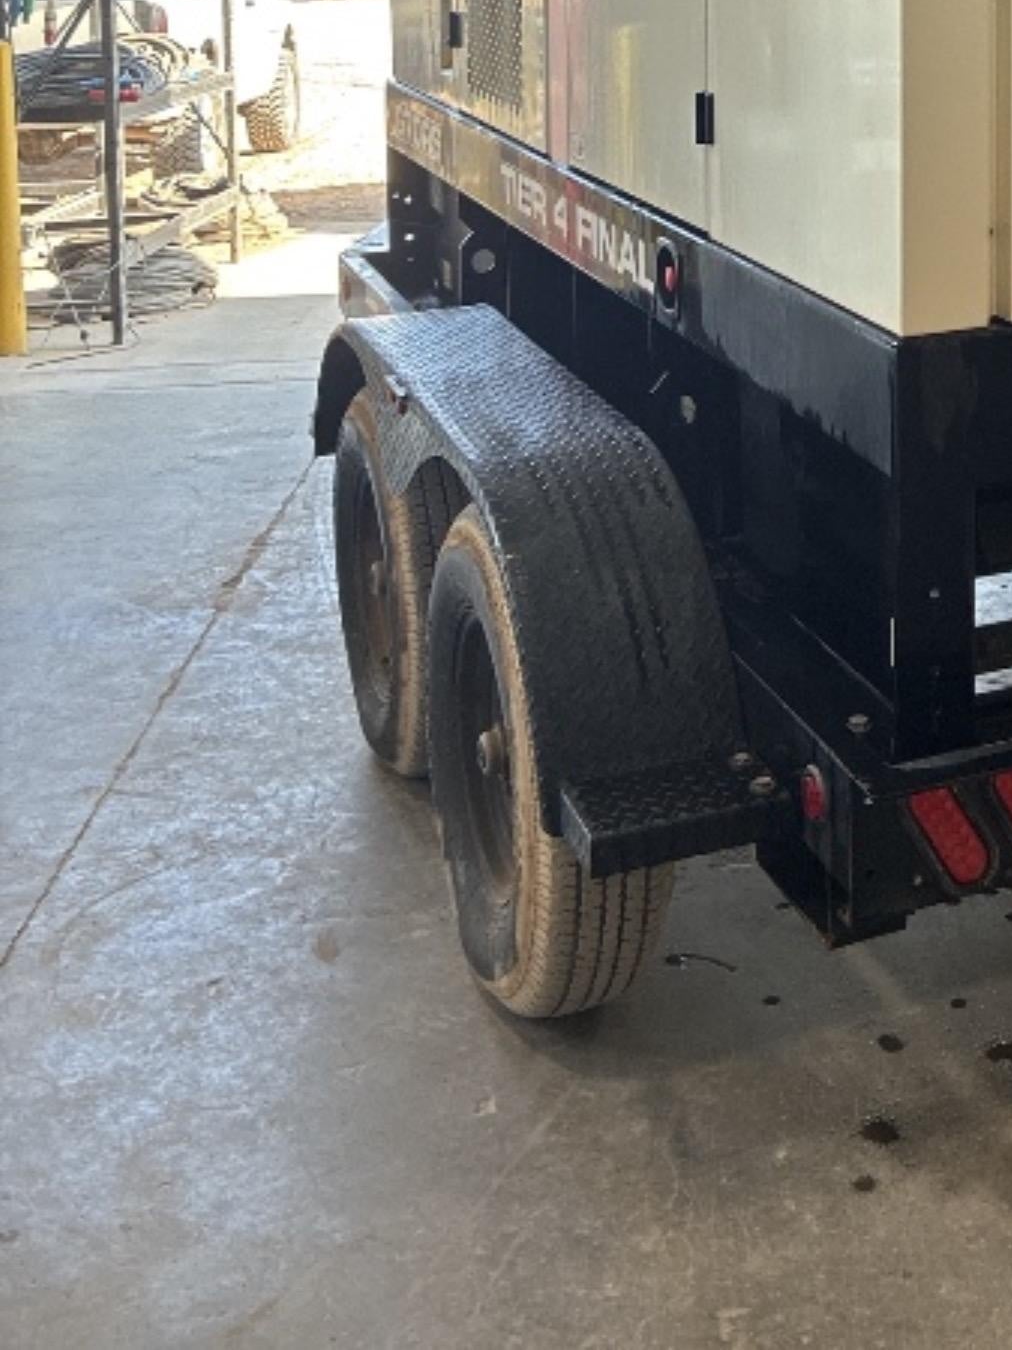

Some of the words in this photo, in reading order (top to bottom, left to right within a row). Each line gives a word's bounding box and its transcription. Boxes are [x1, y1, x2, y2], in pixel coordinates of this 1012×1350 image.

[500, 164, 547, 227] TIER
[554, 194, 568, 243] 4
[575, 204, 655, 295] FINAL
